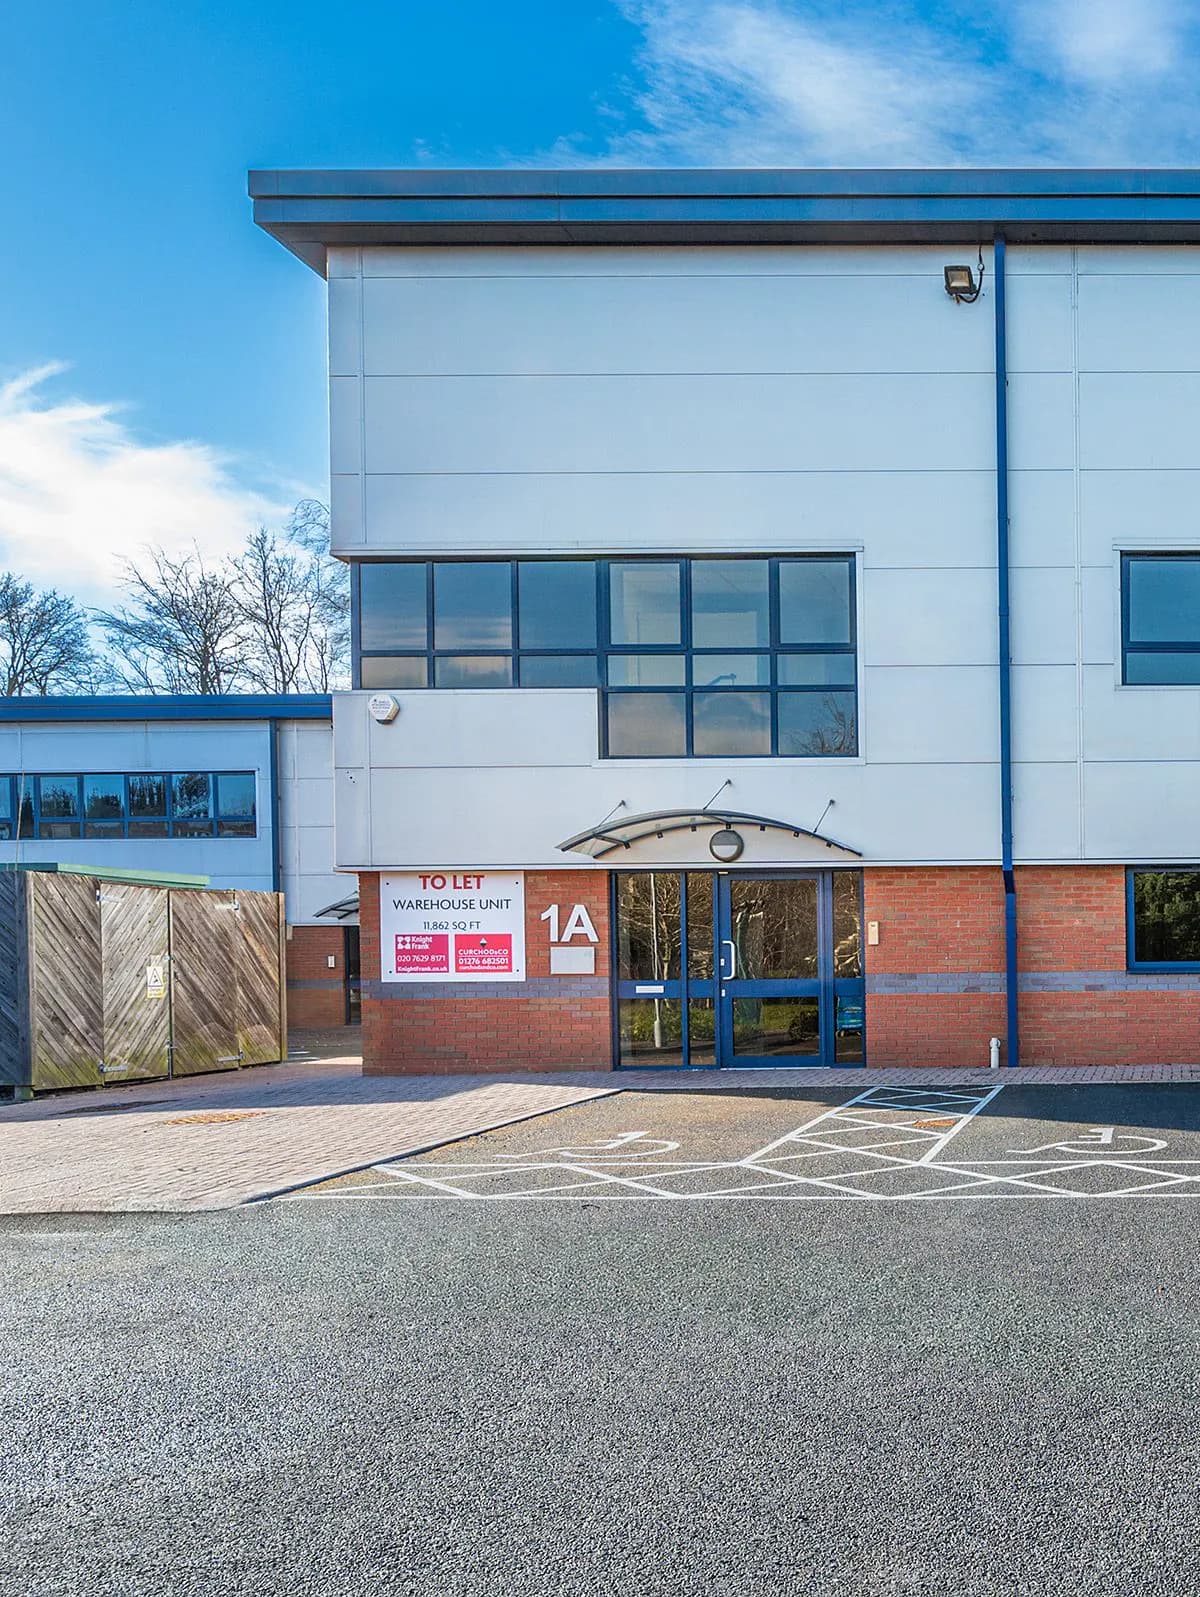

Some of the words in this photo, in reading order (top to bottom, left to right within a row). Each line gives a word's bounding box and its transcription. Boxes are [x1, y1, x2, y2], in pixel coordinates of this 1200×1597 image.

[418, 875, 447, 890] TO
[453, 875, 485, 890] LET
[392, 899, 476, 910] WAREHOUSE
[480, 899, 512, 910] UNIT
[423, 921, 450, 931] 11,862
[451, 921, 467, 931] SQ
[469, 921, 481, 930] FT
[540, 904, 600, 943] 1A
